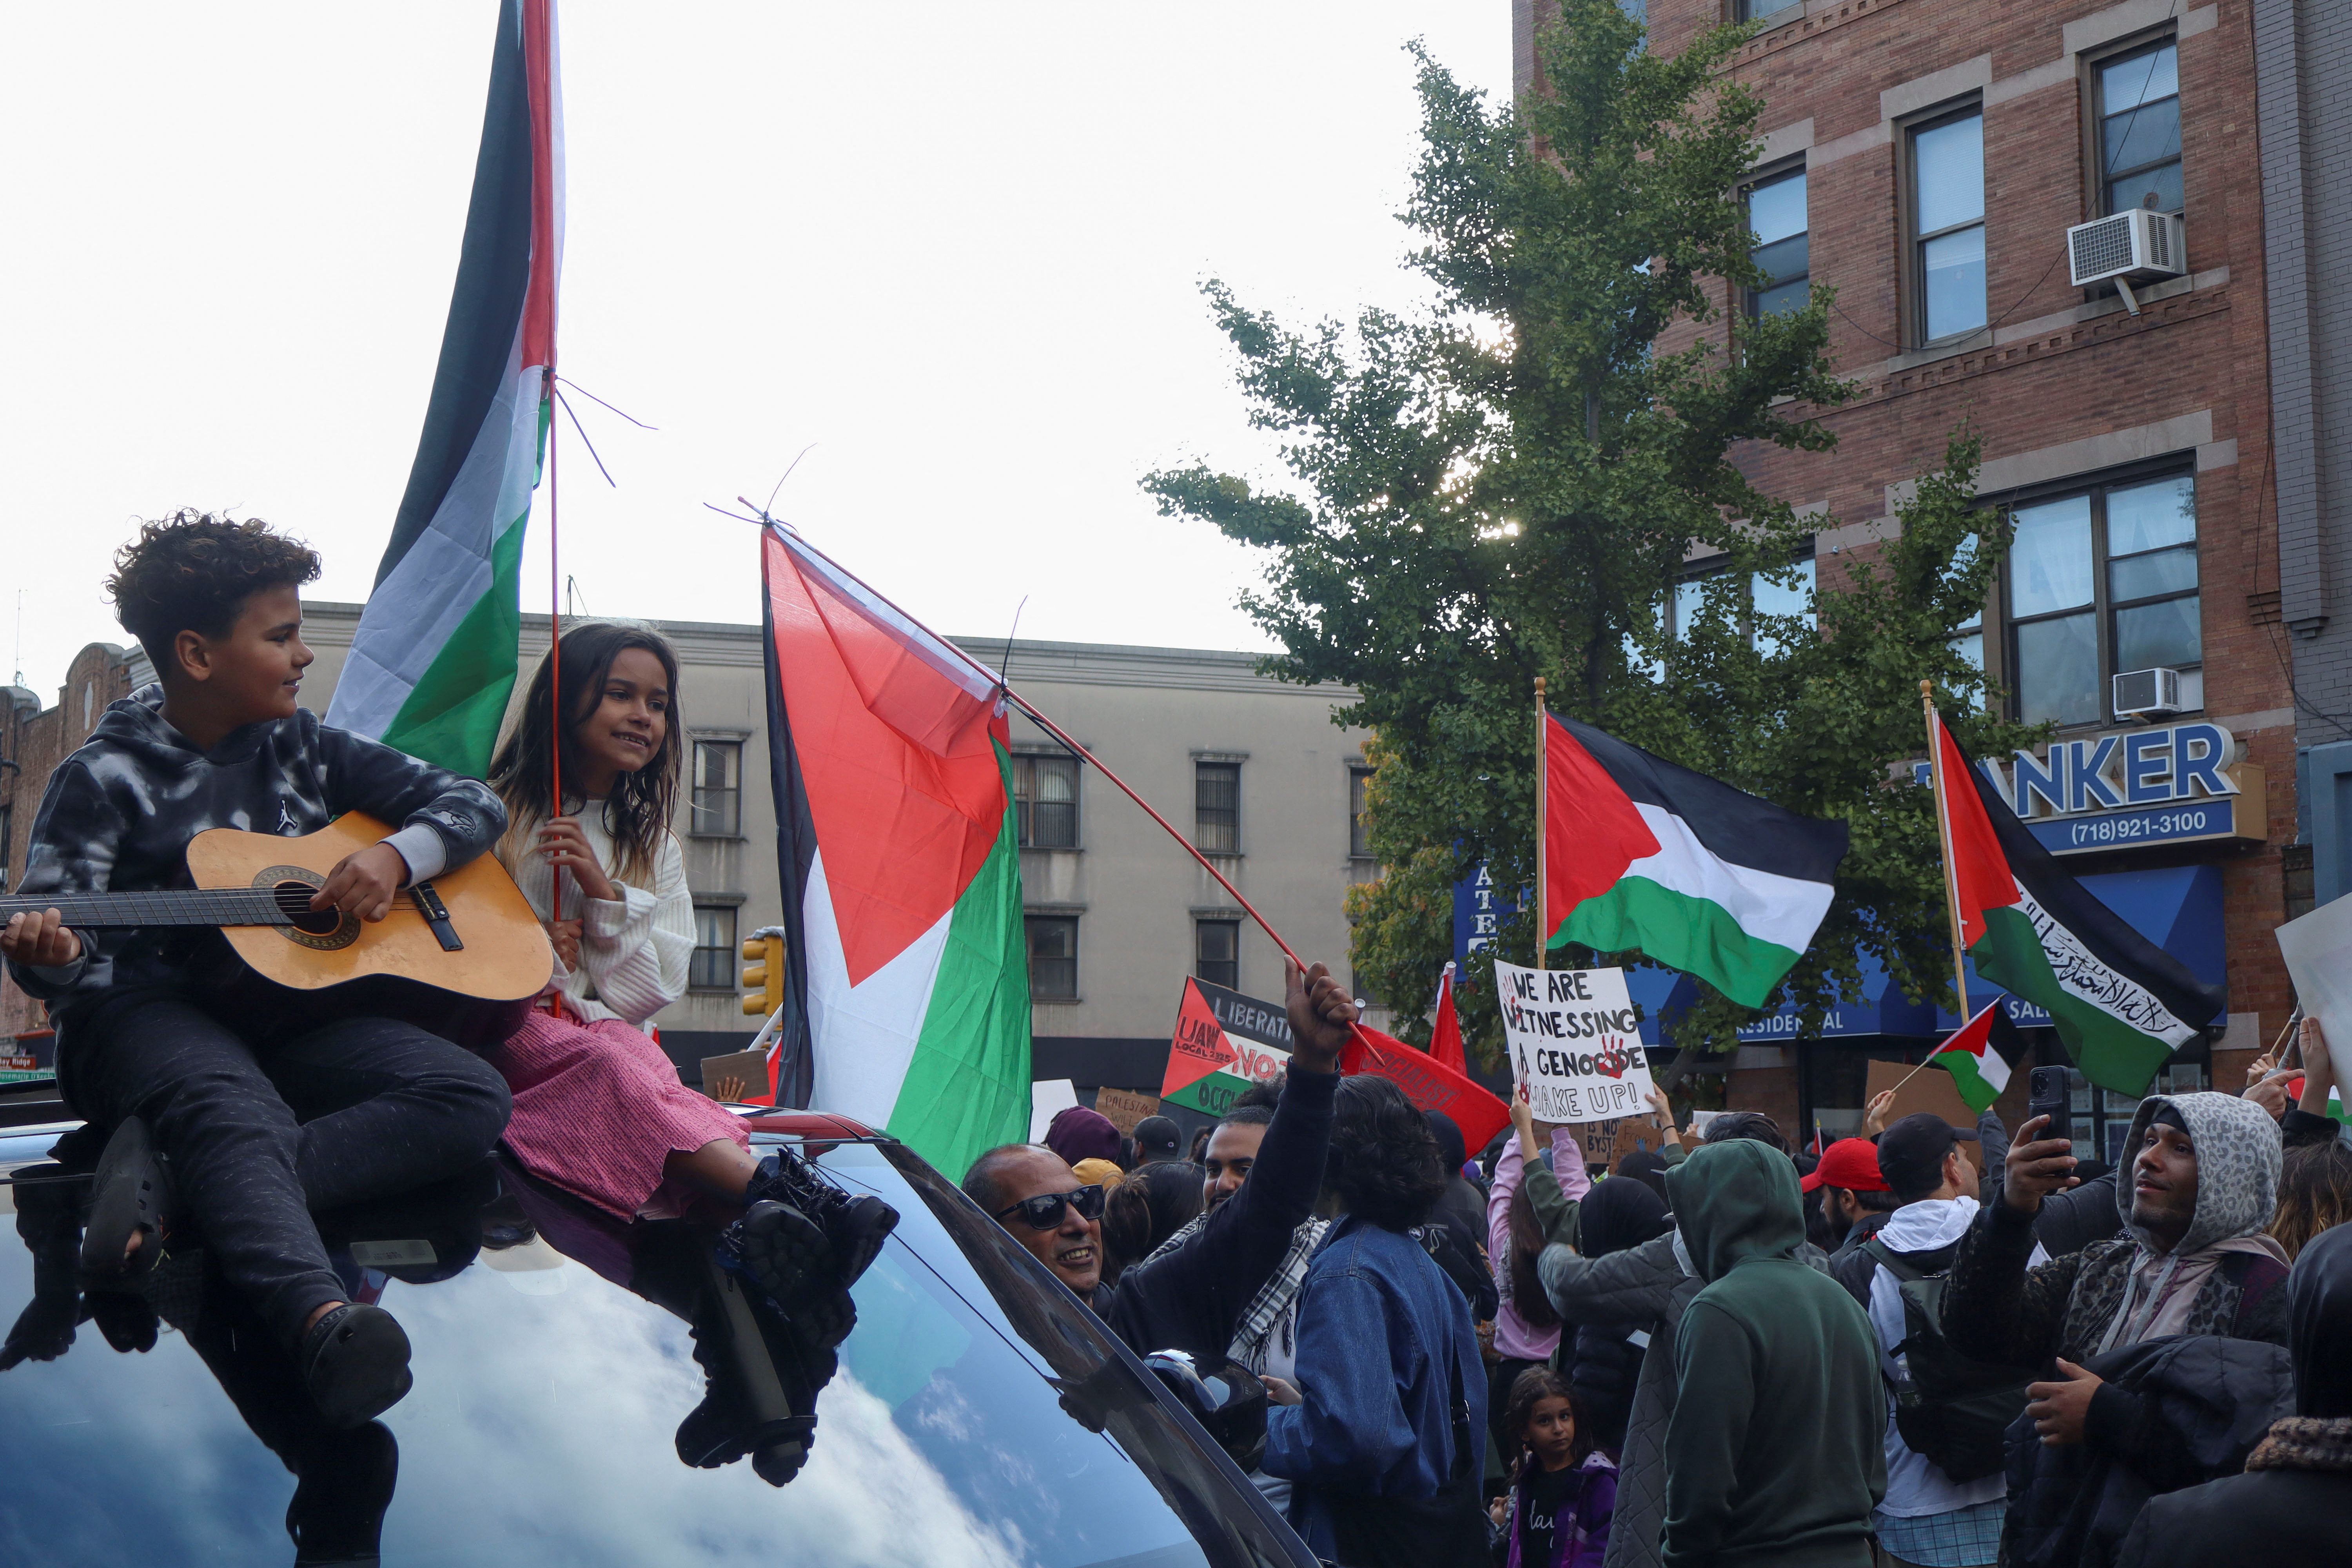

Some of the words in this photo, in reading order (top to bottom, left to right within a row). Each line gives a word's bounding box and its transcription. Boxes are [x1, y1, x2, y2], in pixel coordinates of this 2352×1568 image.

[1912, 722, 2241, 818] NKER
[2071, 811, 2206, 845] (718)921-3100
[1475, 859, 1497, 934] ATE
[1512, 972, 1539, 1001] WE
[1548, 972, 1593, 1003] ARE
[1178, 1016, 1223, 1051] UAW
[1504, 1002, 1637, 1038] WITNESSING
[12, 1057, 31, 1067] Ridge
[1176, 1041, 1207, 1058] LOCAL
[1209, 1051, 1231, 1063] 2325
[1519, 1042, 1530, 1074] A
[1537, 1046, 1646, 1077] GENOCIDE
[1361, 1047, 1458, 1107] SOCIALIST
[1105, 1094, 1157, 1116] PALESTINE
[1528, 1083, 1582, 1117] WAKE
[1588, 1082, 1640, 1114] UP!
[1111, 1112, 1138, 1127] WILL
[1624, 1125, 1652, 1145] From
